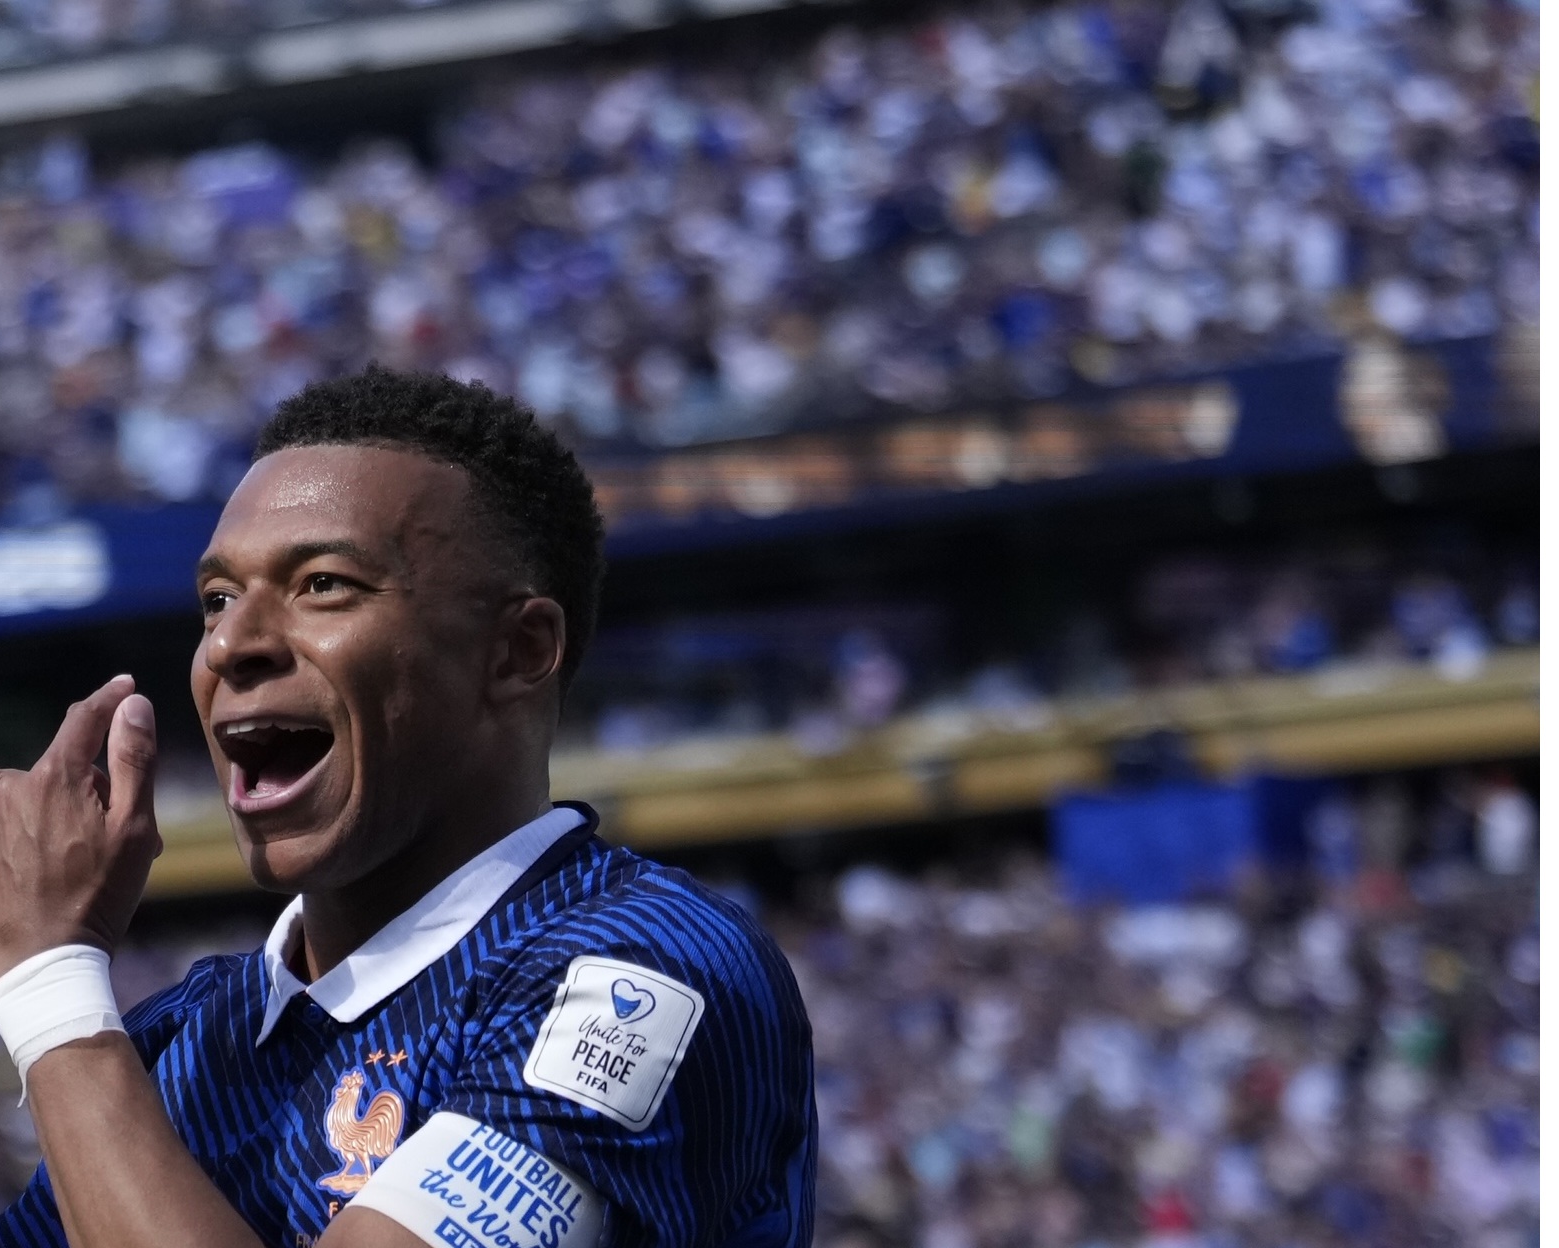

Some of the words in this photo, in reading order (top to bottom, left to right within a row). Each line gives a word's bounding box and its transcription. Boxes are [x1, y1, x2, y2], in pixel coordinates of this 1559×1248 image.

[578, 1014, 623, 1045] Unite
[623, 1033, 648, 1057] For
[571, 1038, 636, 1086] PEACE
[575, 1070, 608, 1094] FIFA
[418, 1167, 467, 1209] the
[470, 1122, 582, 1223] FOOTBALL
